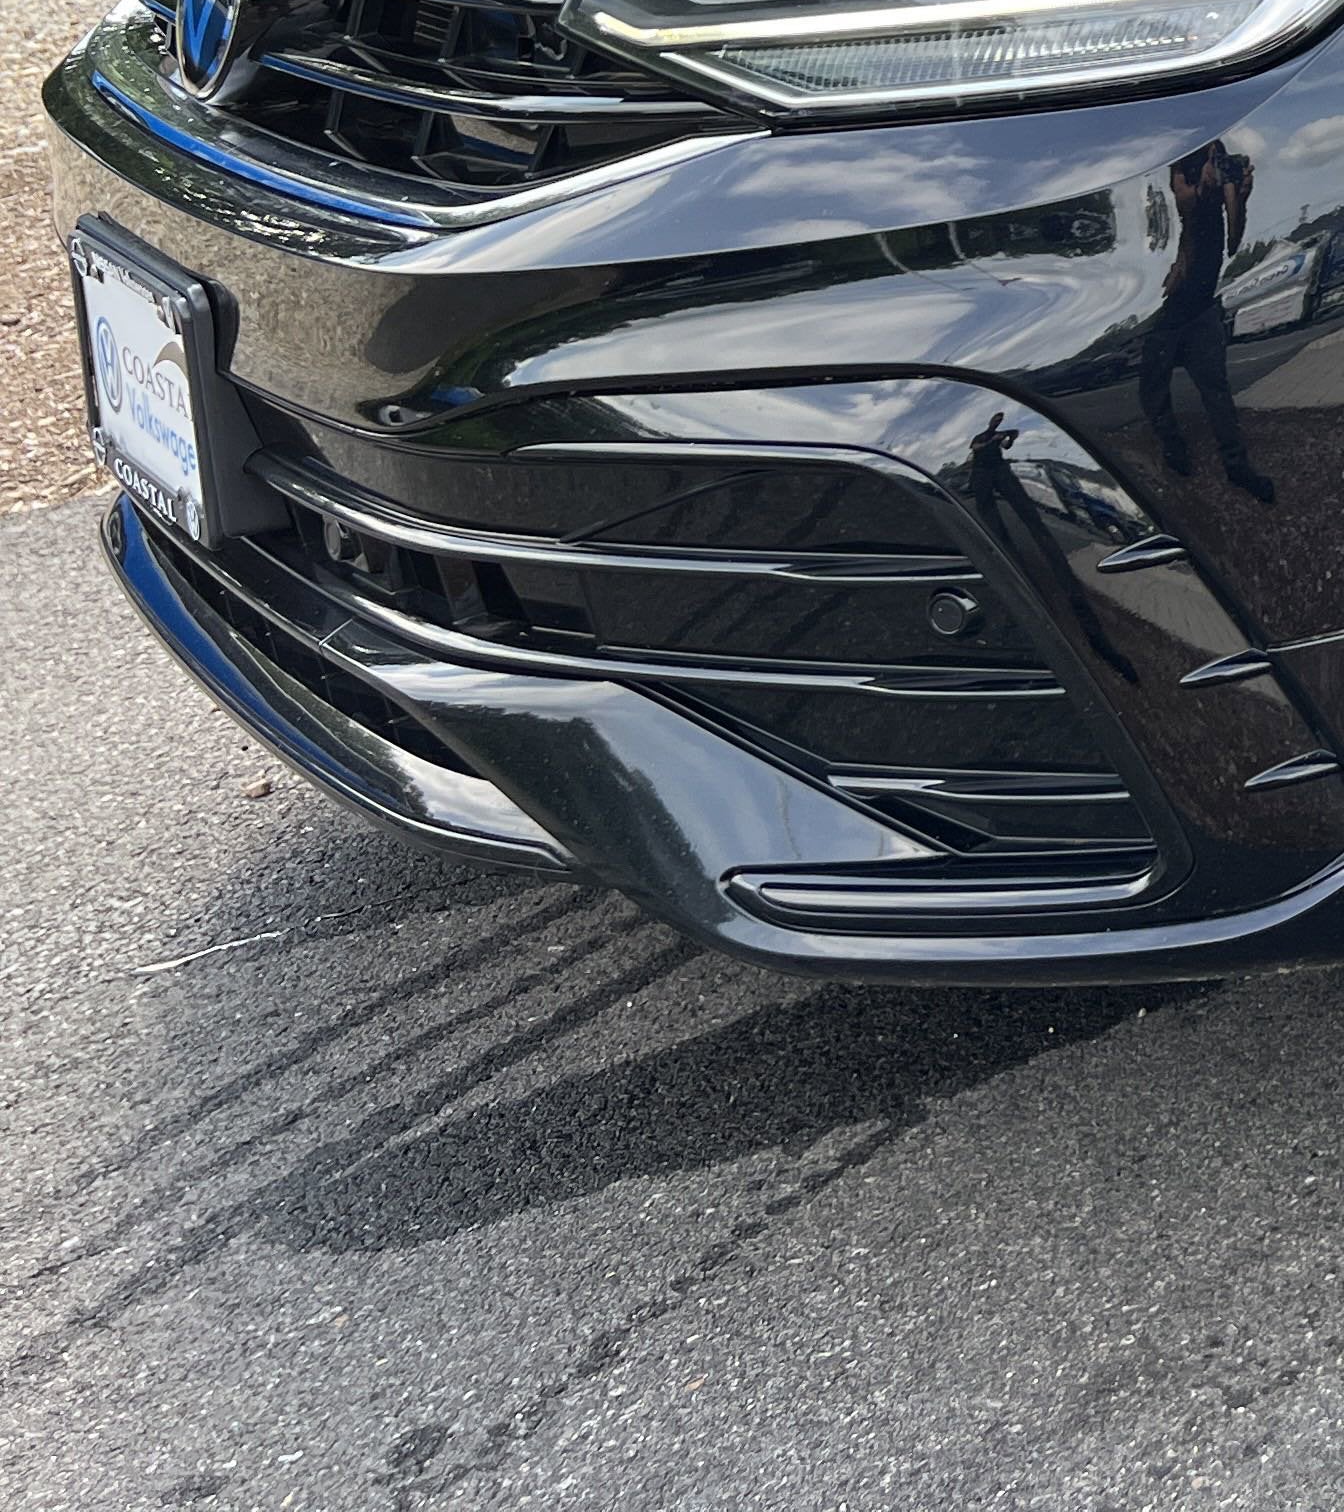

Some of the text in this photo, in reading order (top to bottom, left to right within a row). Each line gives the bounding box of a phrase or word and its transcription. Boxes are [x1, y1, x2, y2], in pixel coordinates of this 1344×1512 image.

[121, 345, 191, 423] COASTA
[126, 381, 197, 477] Volkswage
[114, 457, 177, 522] COASTAL
